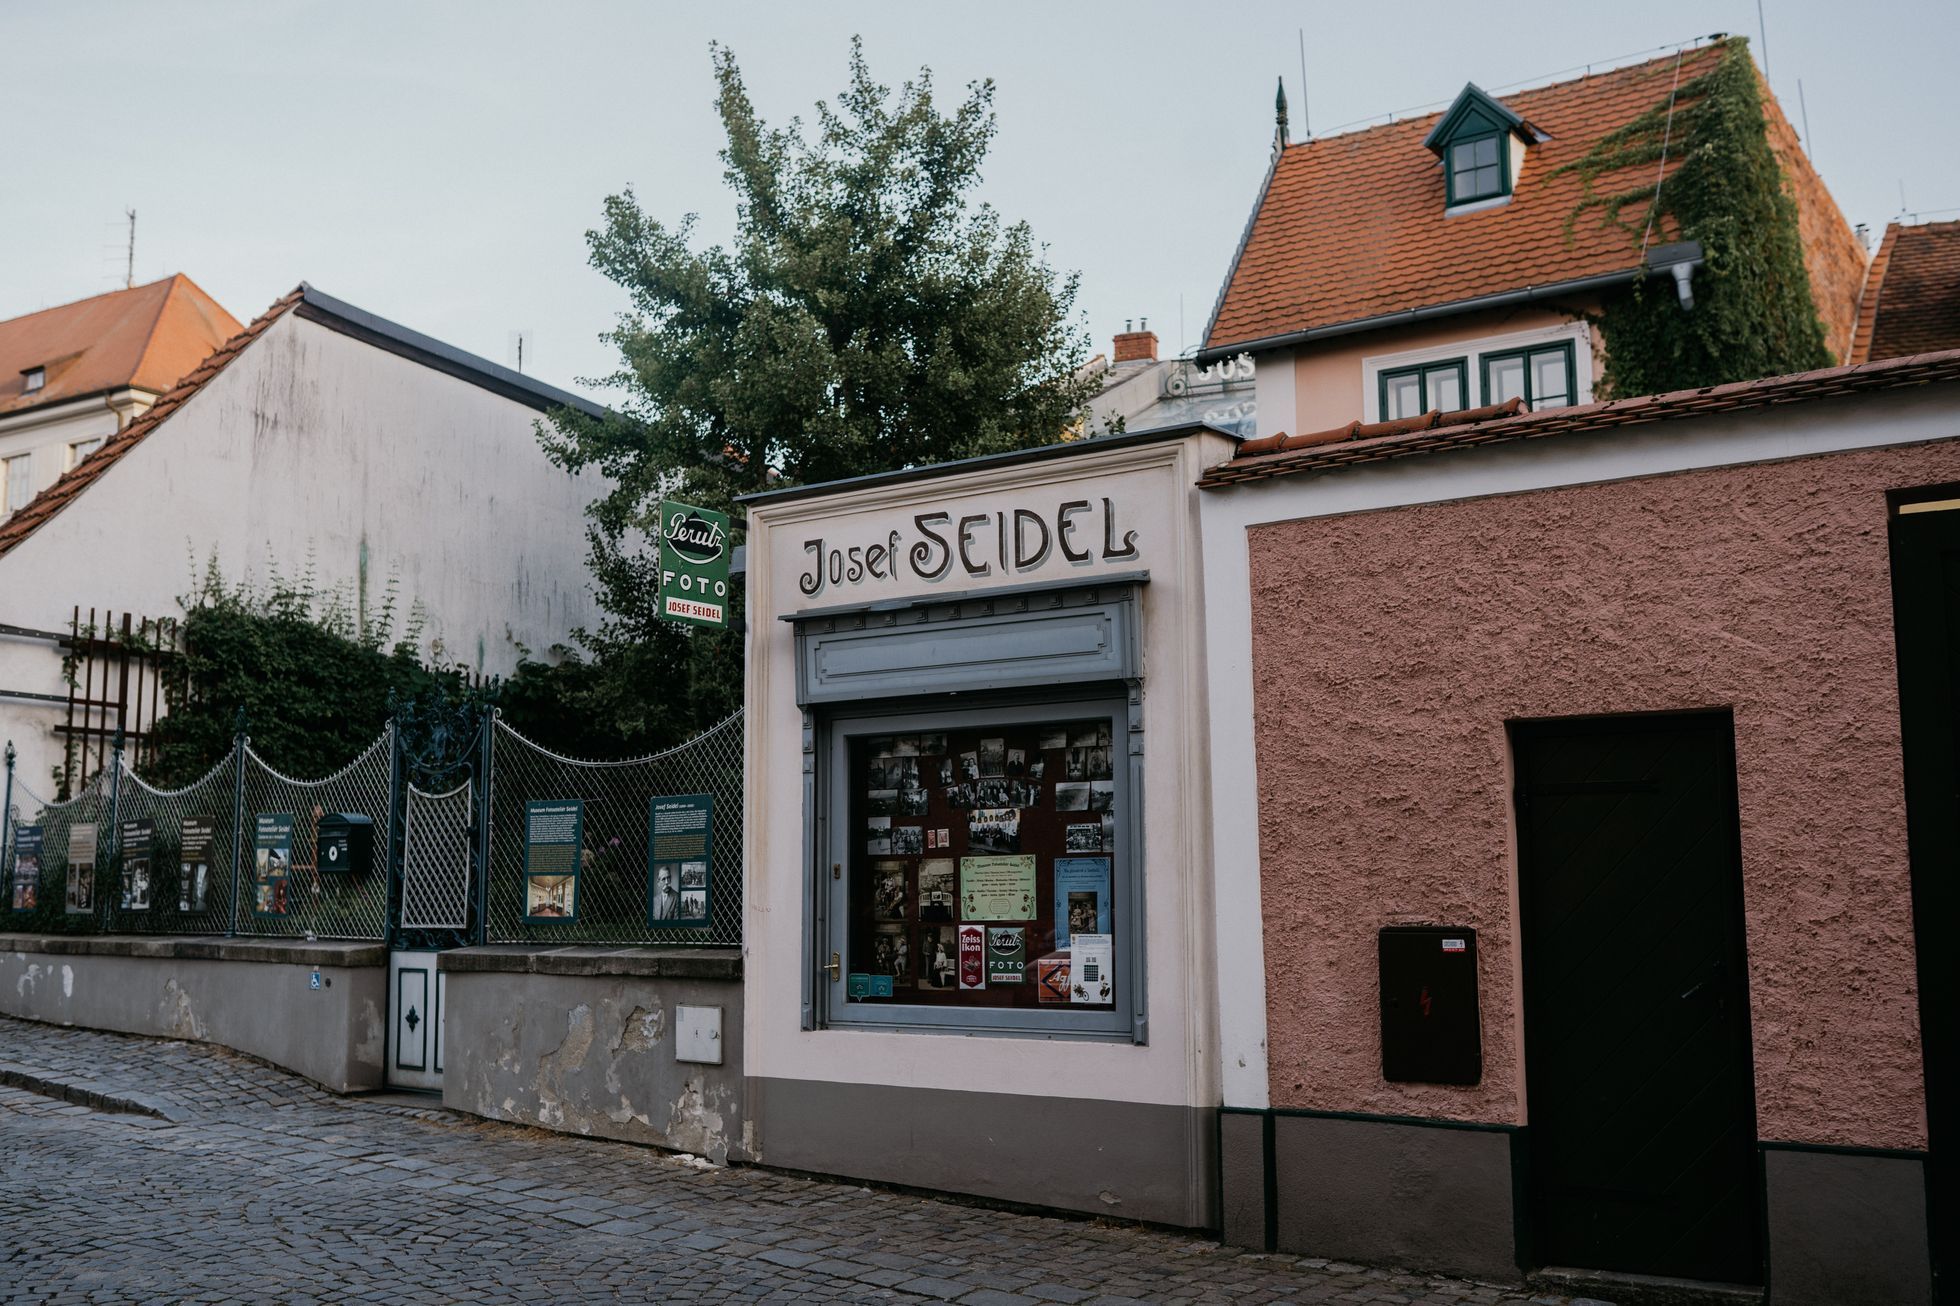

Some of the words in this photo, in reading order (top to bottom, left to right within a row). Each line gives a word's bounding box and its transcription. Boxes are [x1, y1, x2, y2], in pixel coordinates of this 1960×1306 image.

[664, 512, 725, 550] Perutz
[800, 530, 901, 597] Josef
[910, 497, 1138, 582] SEIDEL
[663, 570, 726, 597] FOTO
[668, 601, 693, 614] JOSEF
[693, 605, 721, 619] SEIDEL
[655, 803, 666, 811] Josef
[666, 802, 679, 810] Seidel
[962, 934, 981, 944] Zeiss
[962, 943, 981, 952] Ikon
[989, 961, 1024, 970] FOTO
[1047, 970, 1071, 993] Agf
